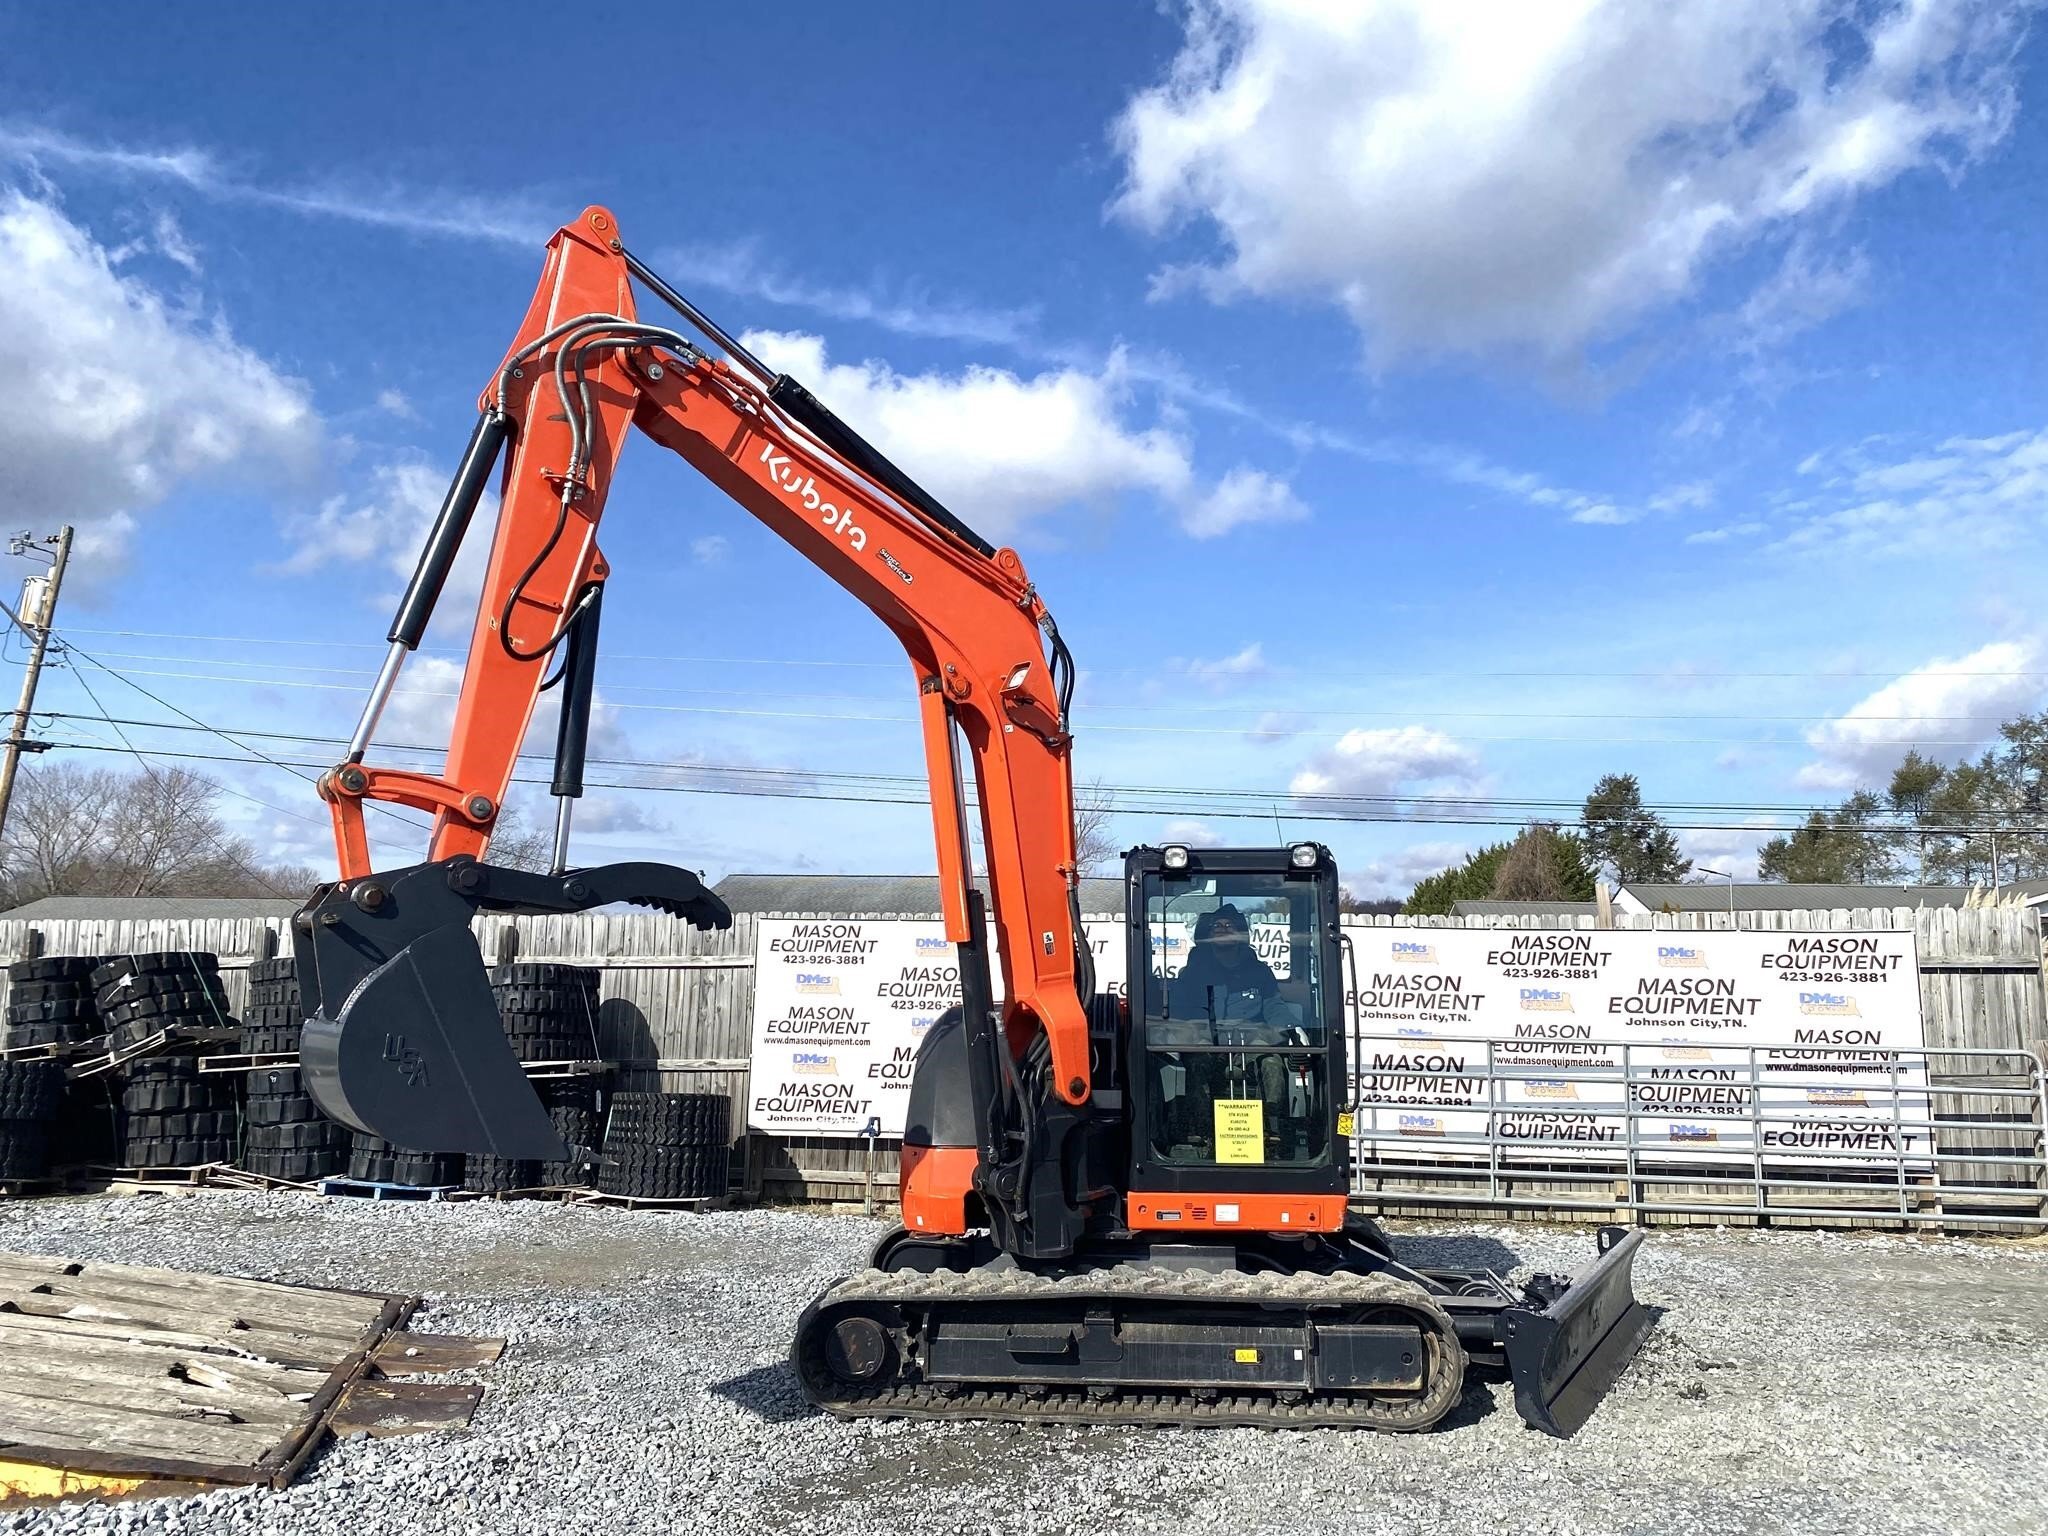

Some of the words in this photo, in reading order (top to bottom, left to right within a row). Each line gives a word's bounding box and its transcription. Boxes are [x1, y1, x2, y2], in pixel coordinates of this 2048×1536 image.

[760, 443, 867, 552] Kubota
[792, 925, 862, 938] MASON
[769, 939, 879, 953] EQUIPMENT
[1511, 936, 1591, 950] MASON
[1788, 938, 1878, 953] MASON
[783, 955, 865, 964] 423-926-3881
[1487, 951, 1612, 966] EQUIPMENT
[1761, 954, 1903, 970] EQUIPMENT
[900, 967, 962, 982] MASO
[1502, 968, 1598, 979] 423-926-3881
[1779, 972, 1887, 982] 423-926-3881
[1372, 973, 1461, 992] MASON
[1638, 978, 1735, 995] MASON
[877, 983, 963, 998] EQUIPME
[891, 1000, 963, 1010] 423-926-3
[1345, 991, 1485, 1010] EQUIPMENT
[1608, 997, 1762, 1015] EQUIPMENT
[788, 1006, 855, 1020] MASON
[1360, 1010, 1415, 1020] Johnson
[767, 1020, 871, 1034] EQUIPMENT
[1625, 1018, 1685, 1027] Johnson
[1515, 1024, 1591, 1038] MASON
[1795, 1029, 1881, 1045] MASON
[763, 1036, 871, 1047] www.dmasonequipment.com
[1768, 1050, 1899, 1061] EQUIPMEN
[1372, 1053, 1464, 1073] MASON
[1765, 1063, 1907, 1075] www.dmasonequipment.cm
[779, 1083, 854, 1098] MASON
[881, 1082, 912, 1090] John
[755, 1098, 873, 1114] EQUIPMENT
[1763, 1131, 1917, 1151] EQUIPMENT
